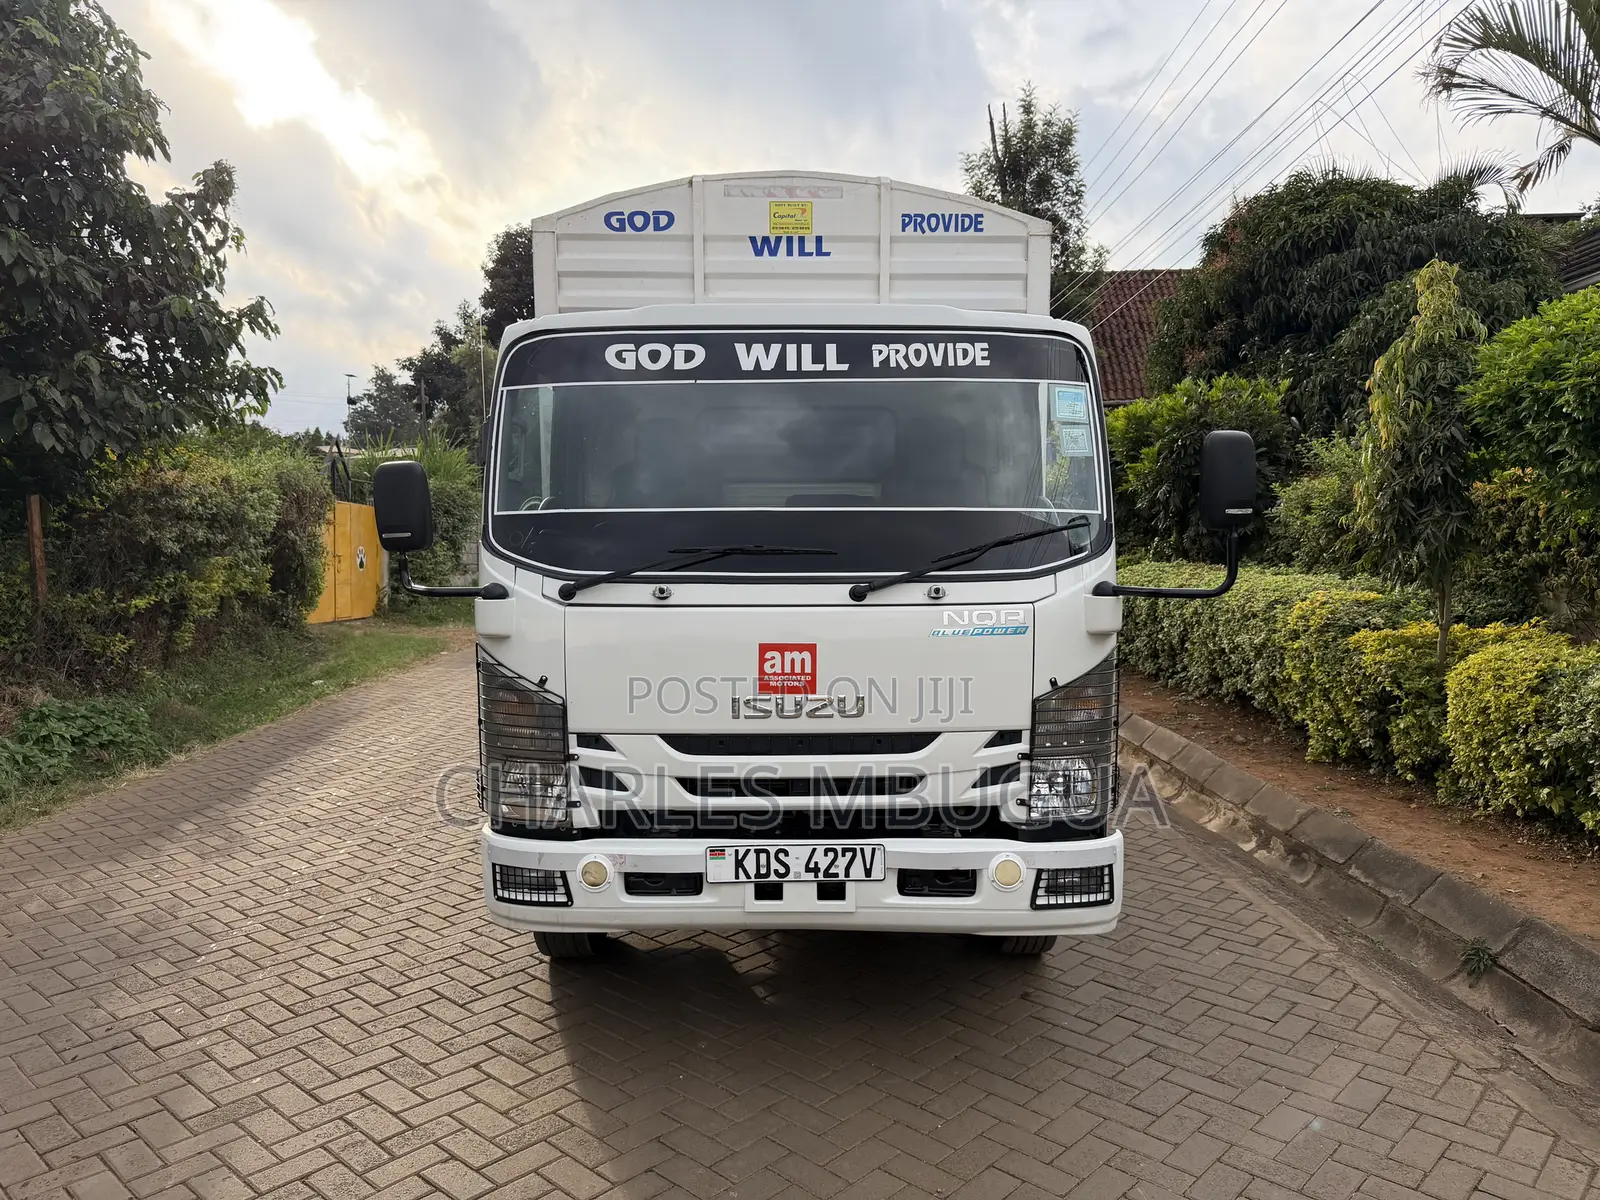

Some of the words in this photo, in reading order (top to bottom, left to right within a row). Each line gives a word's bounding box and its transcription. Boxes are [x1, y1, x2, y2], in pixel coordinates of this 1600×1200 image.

[604, 210, 675, 233] GOD
[901, 213, 985, 234] PROVIDE
[749, 235, 832, 257] WILL
[605, 343, 706, 371] GOD
[734, 343, 850, 372] WILL
[872, 342, 991, 369] PROVIDE
[943, 609, 1026, 626] NQR
[764, 650, 812, 674] am
[731, 695, 866, 719] ISUZU
[734, 848, 791, 880] KDS
[804, 847, 876, 879] 427V
